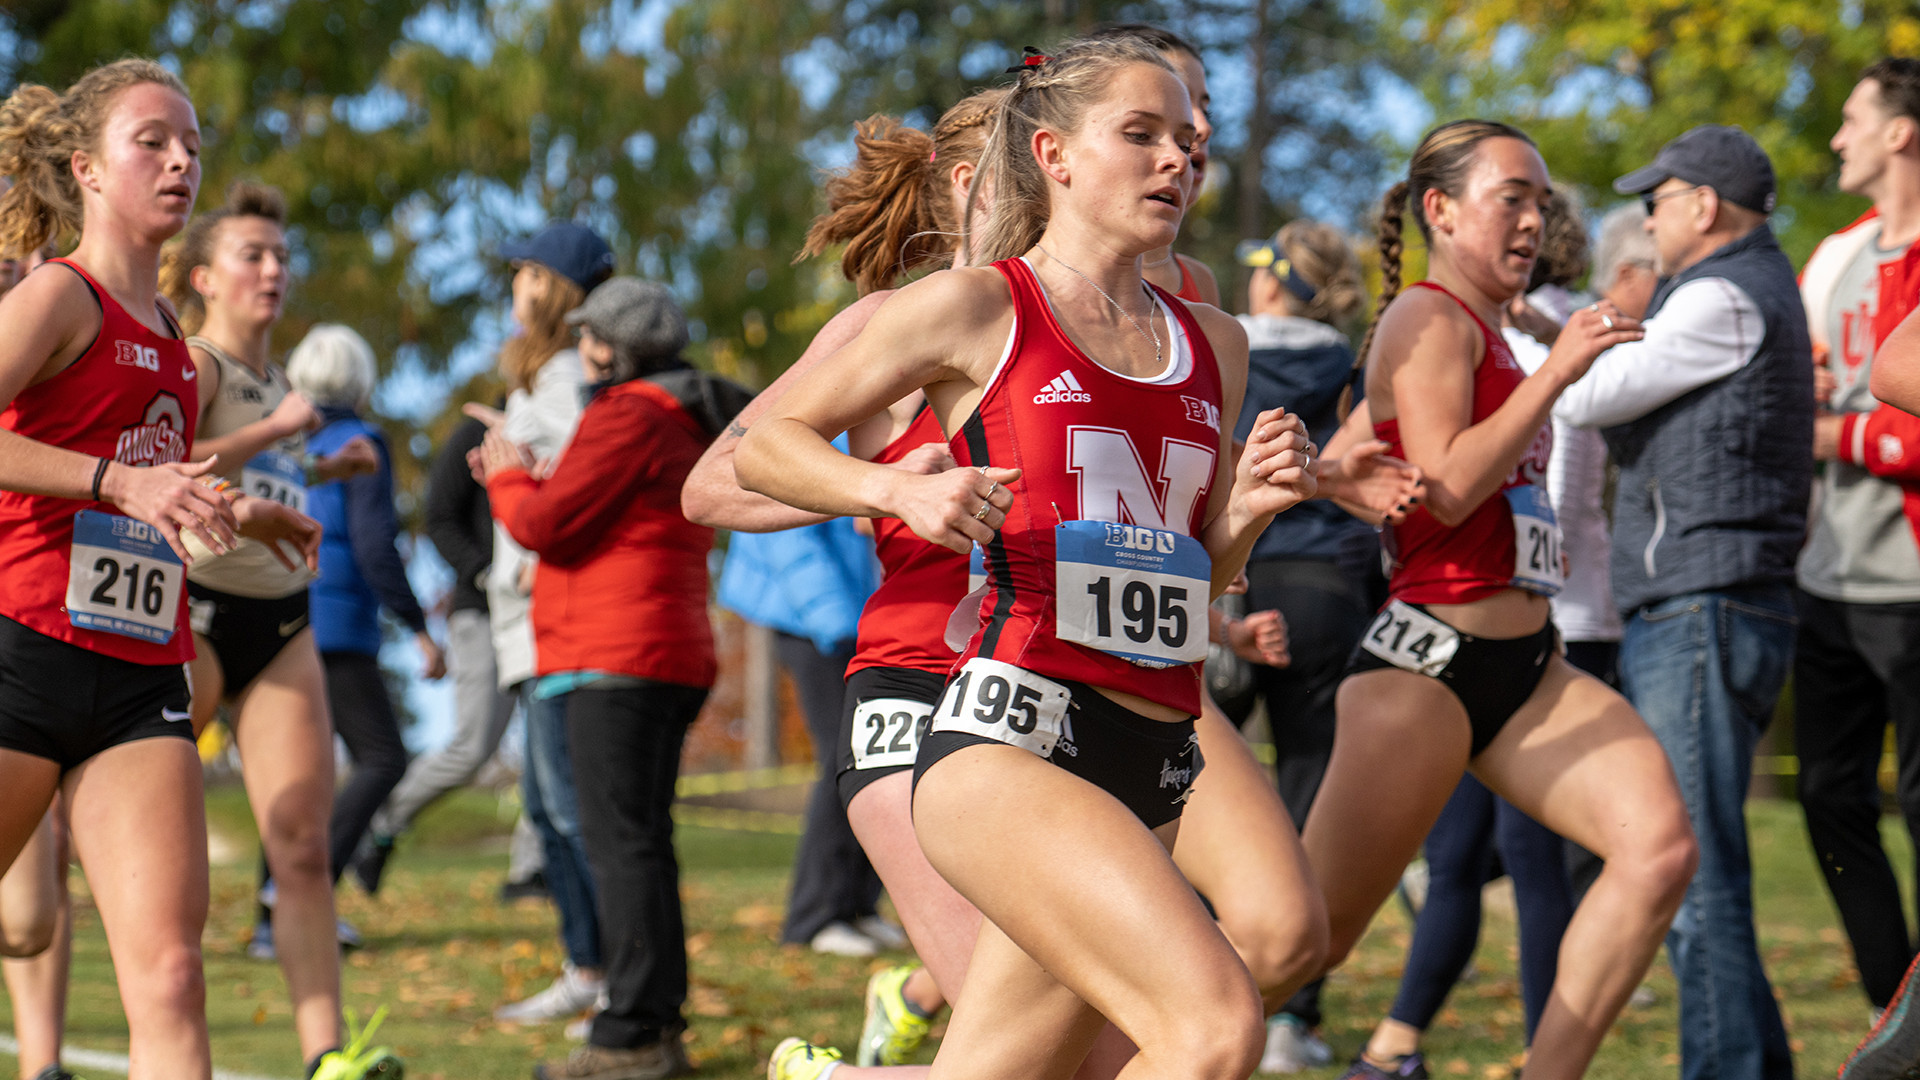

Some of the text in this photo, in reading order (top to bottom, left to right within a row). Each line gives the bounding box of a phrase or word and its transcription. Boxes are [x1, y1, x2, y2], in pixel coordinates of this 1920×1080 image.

[1033, 389, 1092, 404] adidas
[1066, 425, 1216, 537] N
[1115, 551, 1165, 563] CROSS COUNTRY
[89, 556, 165, 617] 216
[1087, 576, 1188, 648] 195
[1371, 610, 1437, 663] 214
[950, 670, 1044, 735] 195
[1056, 735, 1080, 757] das
